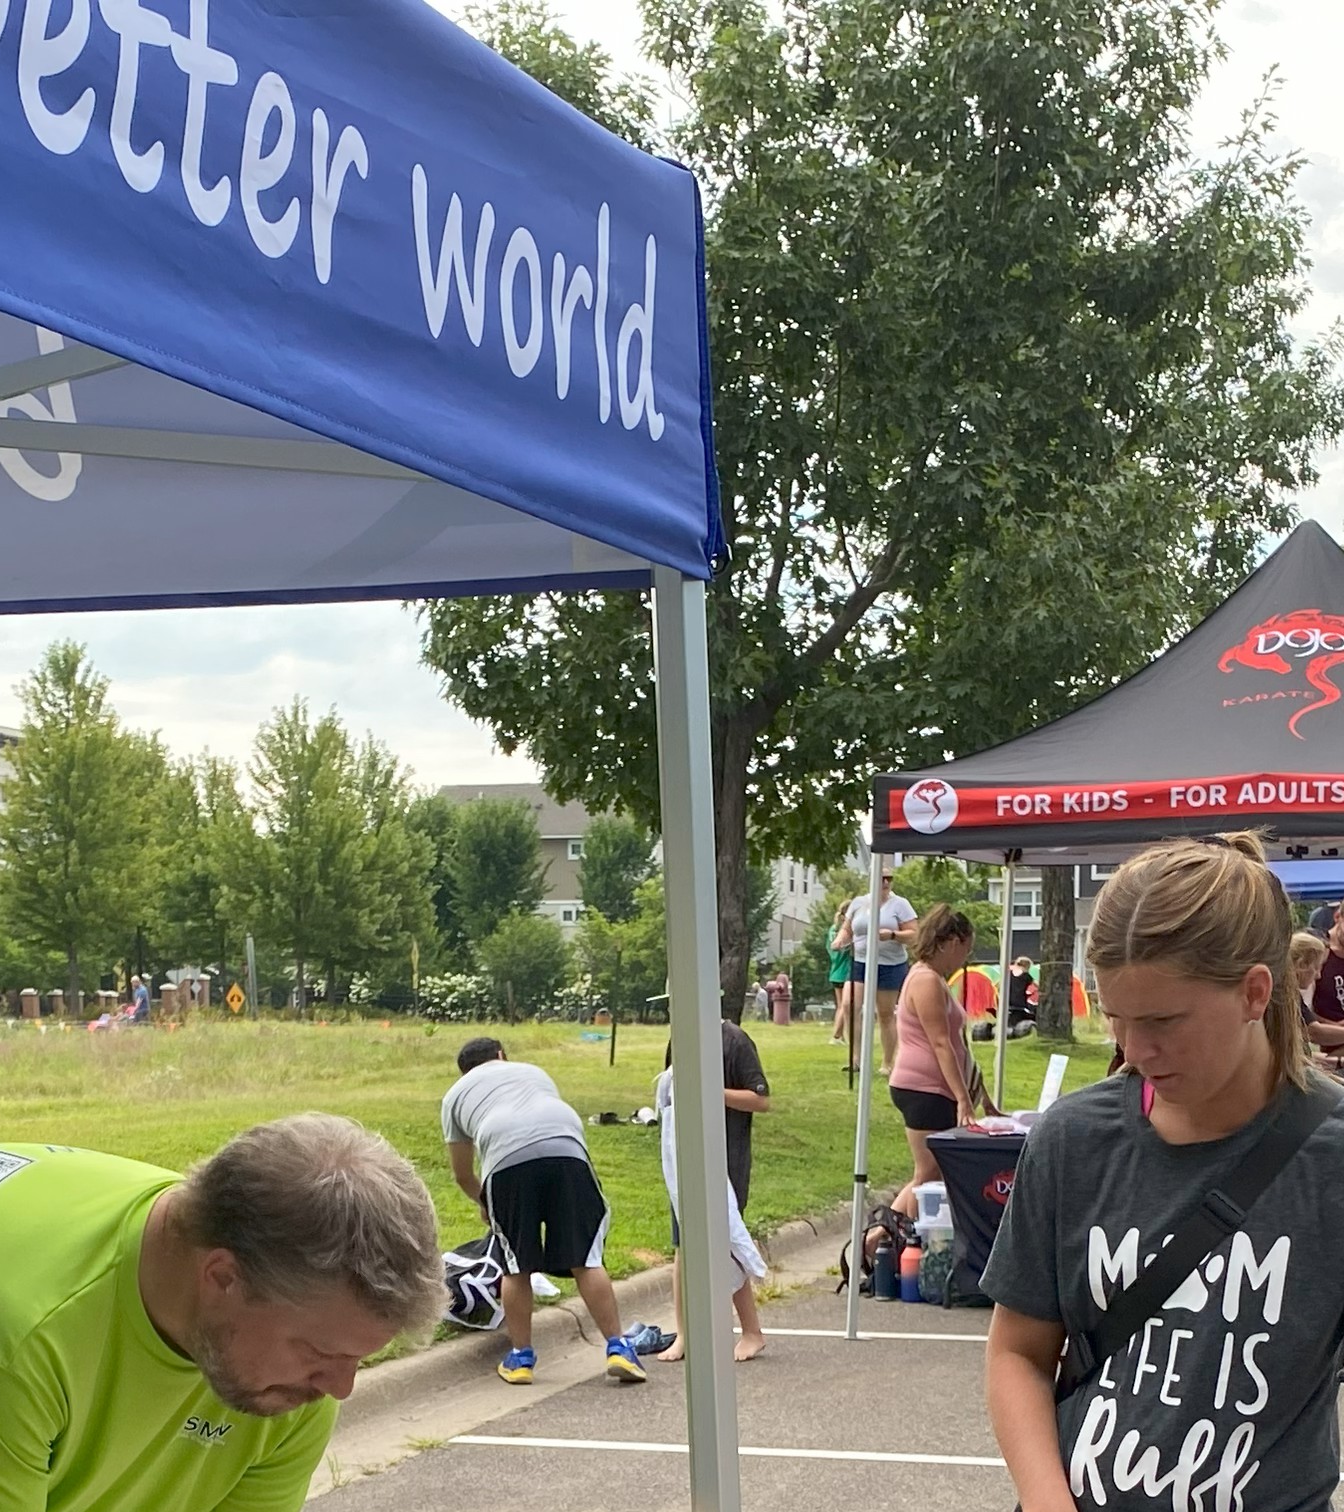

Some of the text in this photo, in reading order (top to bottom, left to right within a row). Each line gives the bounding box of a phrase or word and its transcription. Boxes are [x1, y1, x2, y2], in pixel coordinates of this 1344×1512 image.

[412, 164, 663, 441] world
[1222, 690, 1316, 708] KARATE
[996, 795, 1052, 817] FOR
[1062, 789, 1129, 814] KIDS
[1168, 784, 1228, 808] FOR
[1099, 1317, 1270, 1416] LFE IS
